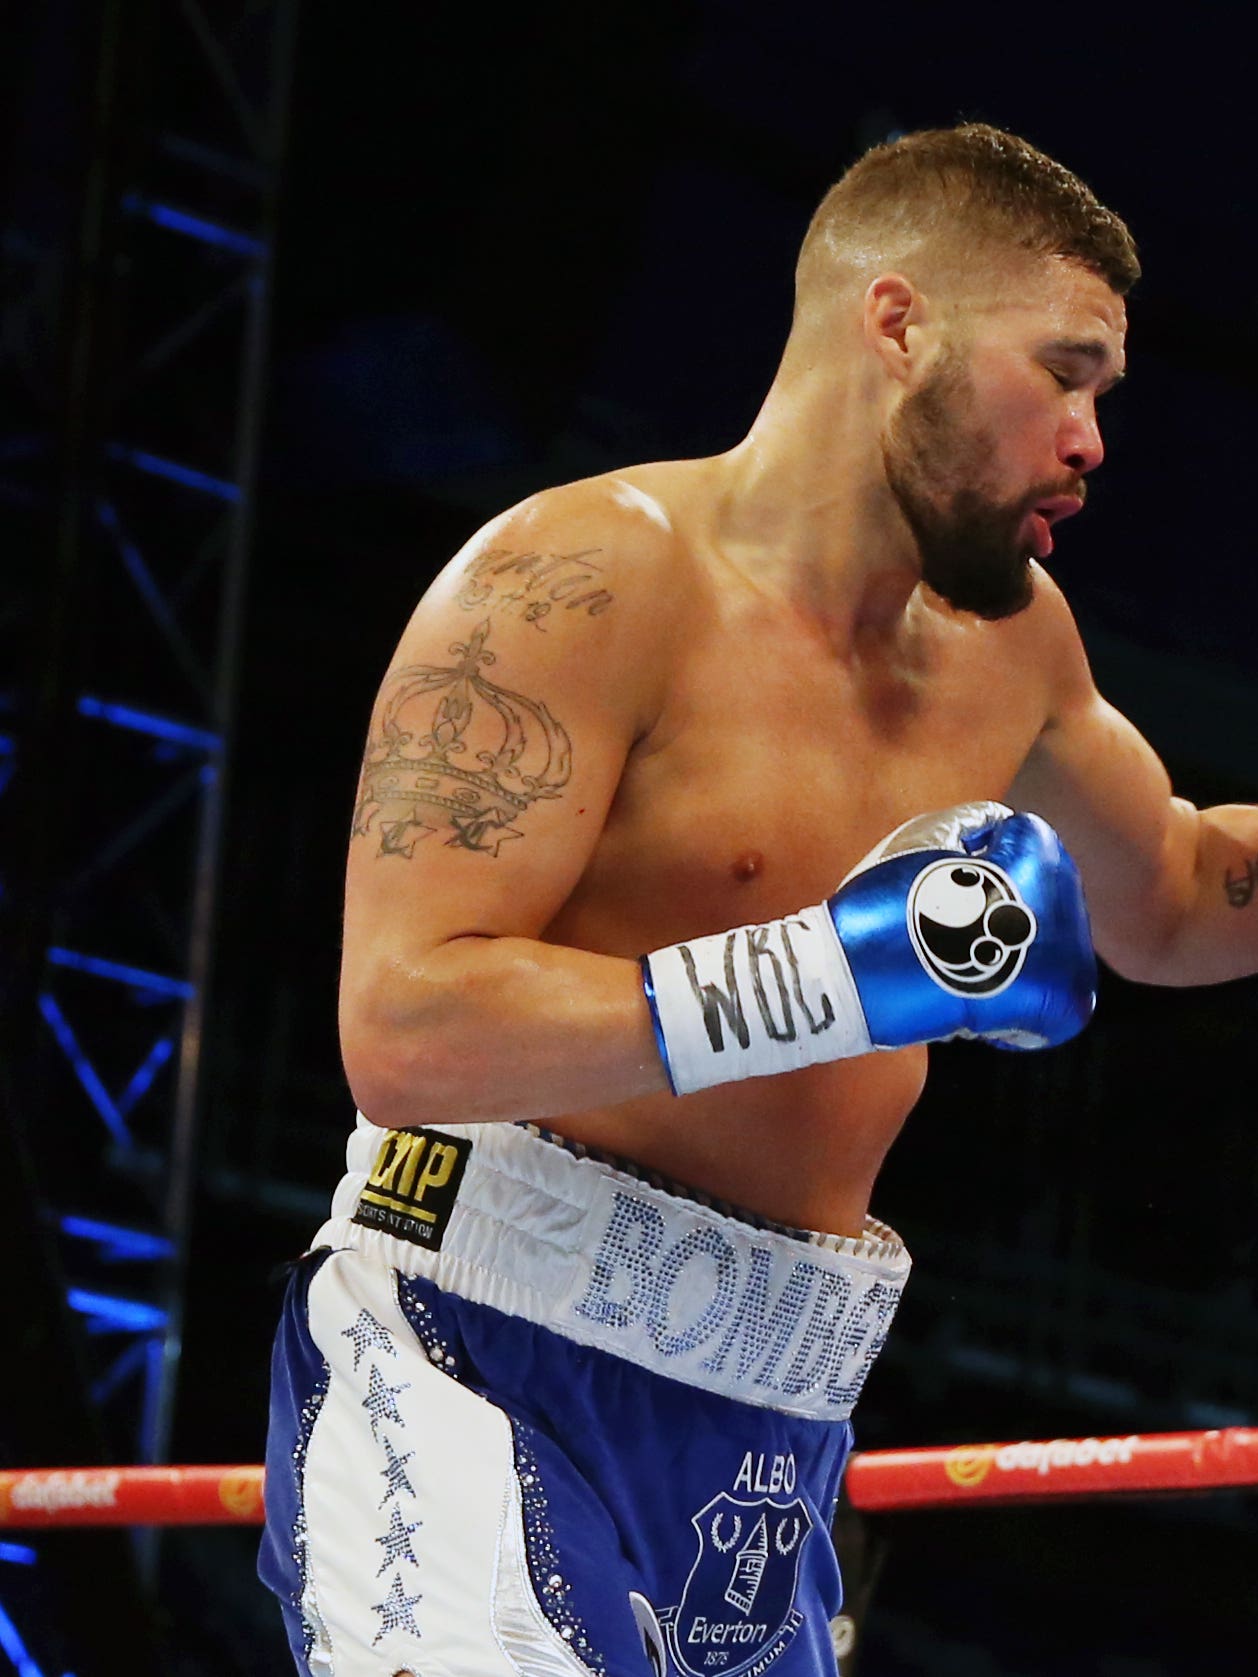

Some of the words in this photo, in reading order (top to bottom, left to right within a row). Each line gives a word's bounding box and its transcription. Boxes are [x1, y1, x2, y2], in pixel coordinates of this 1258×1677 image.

[677, 920, 836, 1053] WBC
[575, 1191, 900, 1404] BOMBE
[733, 1451, 797, 1494] ALBO
[996, 1435, 1140, 1476] dafabet
[687, 1616, 767, 1645] Everton
